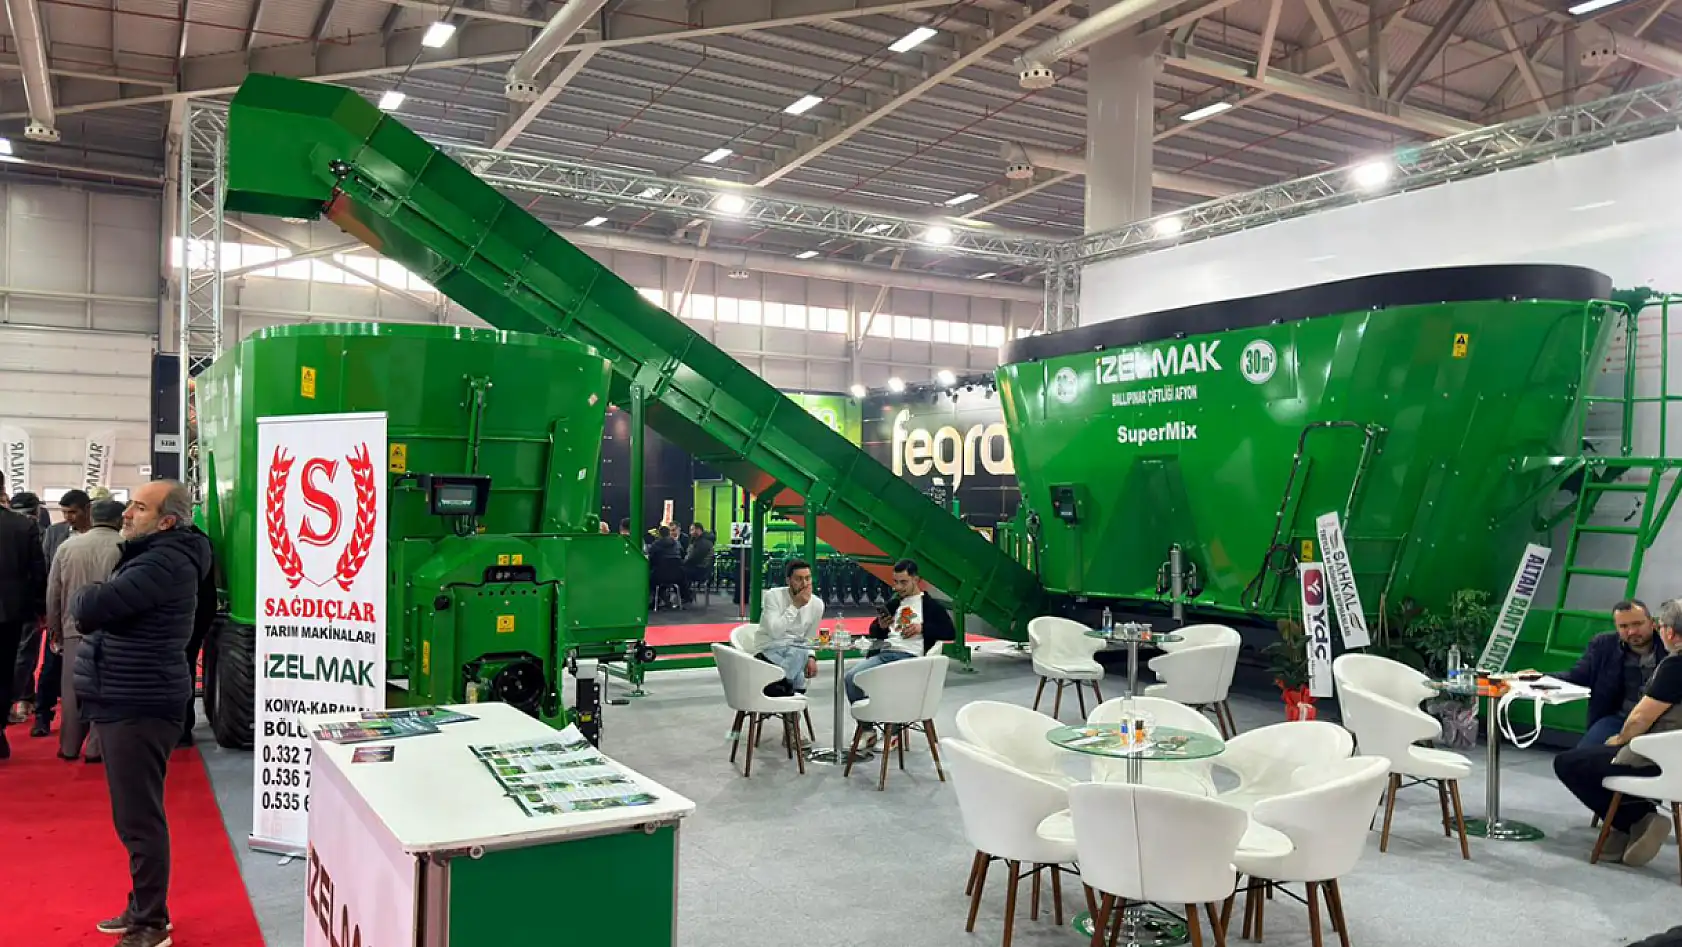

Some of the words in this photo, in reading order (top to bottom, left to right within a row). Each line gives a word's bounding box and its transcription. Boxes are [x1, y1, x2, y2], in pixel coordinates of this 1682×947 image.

[1175, 384, 1198, 401] AFYON
[1117, 420, 1198, 446] SuperMix
[297, 457, 343, 547] S
[1515, 553, 1545, 596] ALTAN
[265, 625, 299, 638] TARIM
[263, 745, 300, 764] 0.332
[262, 768, 301, 787] 0.536
[262, 791, 300, 811] 0.535
